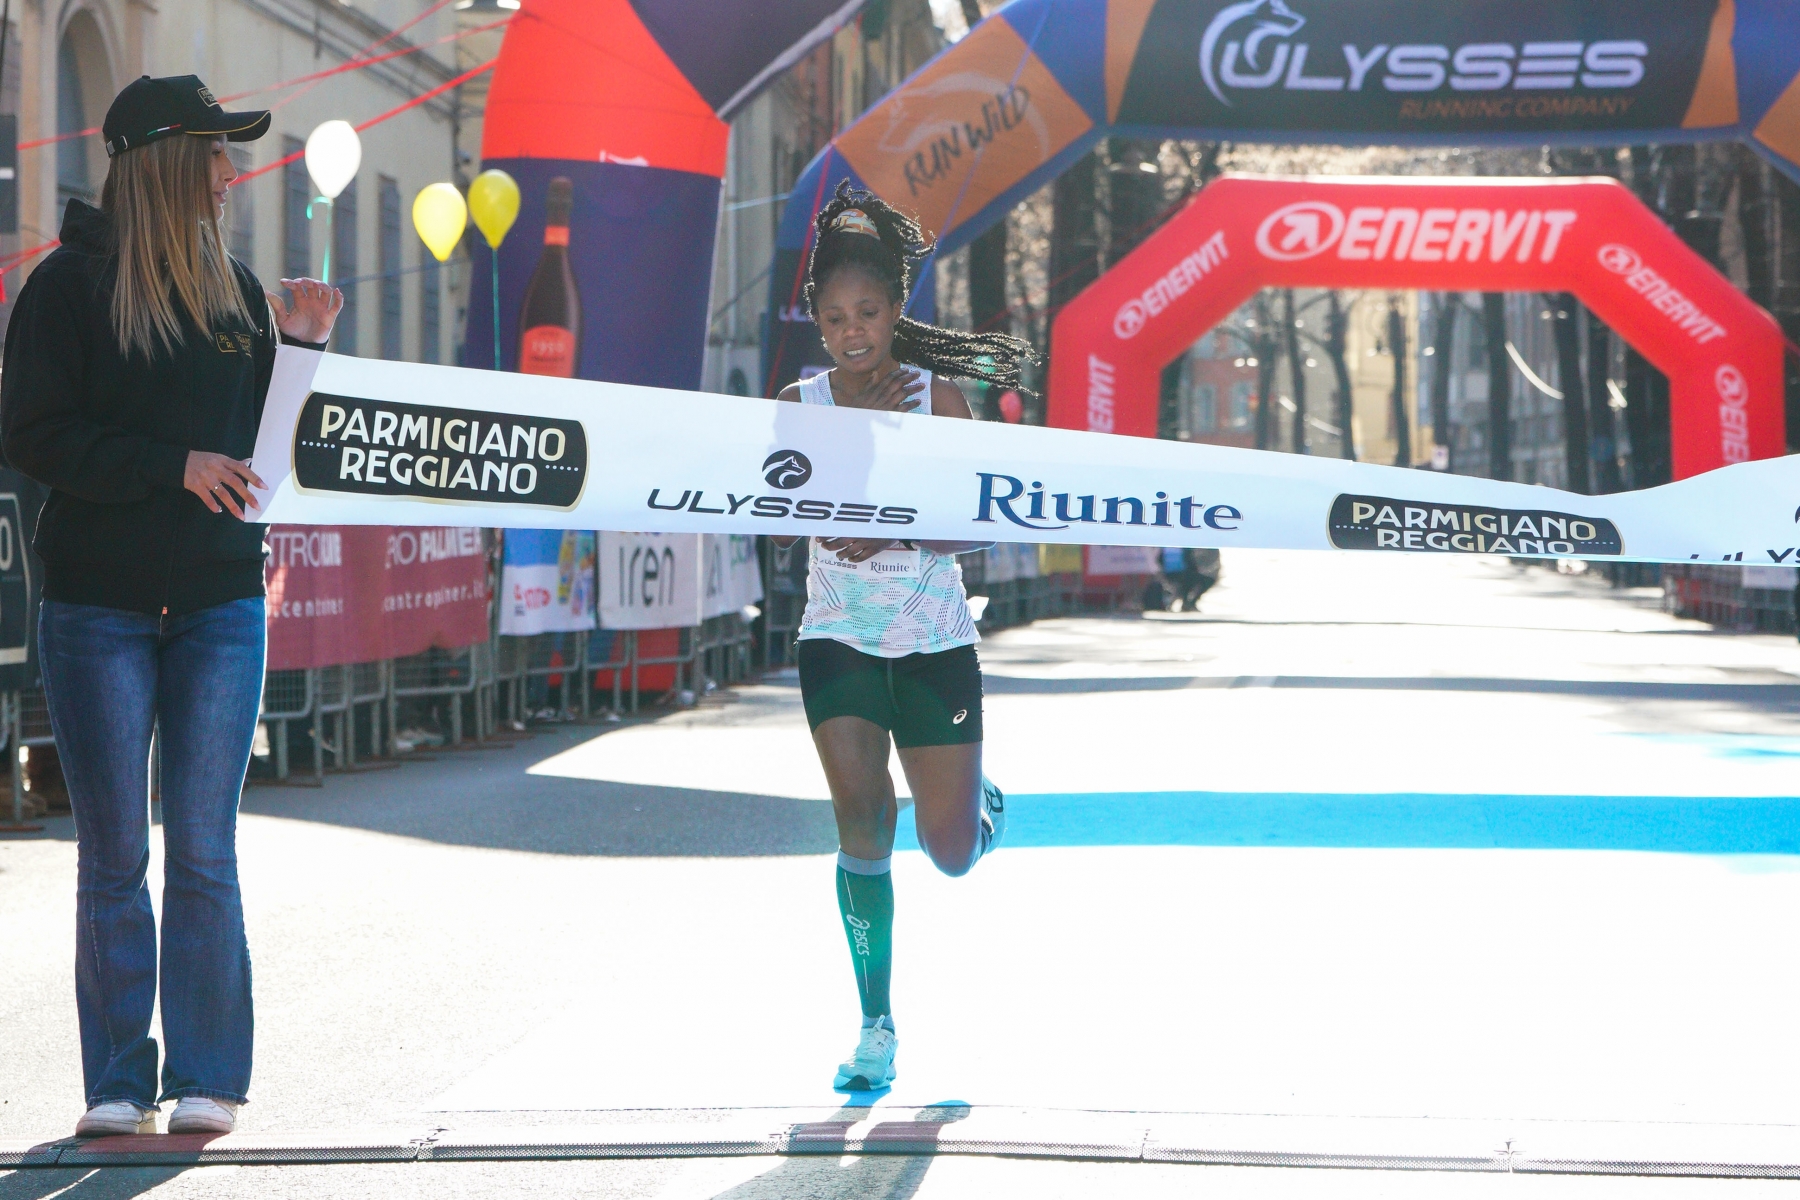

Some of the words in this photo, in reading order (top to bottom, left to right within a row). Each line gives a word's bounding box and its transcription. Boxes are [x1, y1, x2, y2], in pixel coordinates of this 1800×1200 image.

[1220, 40, 1649, 91] ULYSSES
[1399, 98, 1511, 119] RUNNING
[1514, 97, 1635, 117] COMPANY
[903, 125, 962, 198] RUN
[1338, 207, 1577, 262] ENERVIT
[1142, 229, 1229, 318] ENERVIT
[1624, 266, 1728, 344] ENERVIT
[1087, 353, 1116, 434] ERVIT
[319, 404, 566, 461] PARMIGIANO
[338, 446, 538, 494] REGGIANO
[646, 488, 918, 524] ULYSSES
[971, 471, 1244, 530] Riunite
[1352, 502, 1597, 541] PARMIGIANO
[824, 559, 858, 570] ULYSSES
[870, 561, 910, 573] Riunite
[1377, 529, 1575, 554] REGGIANO
